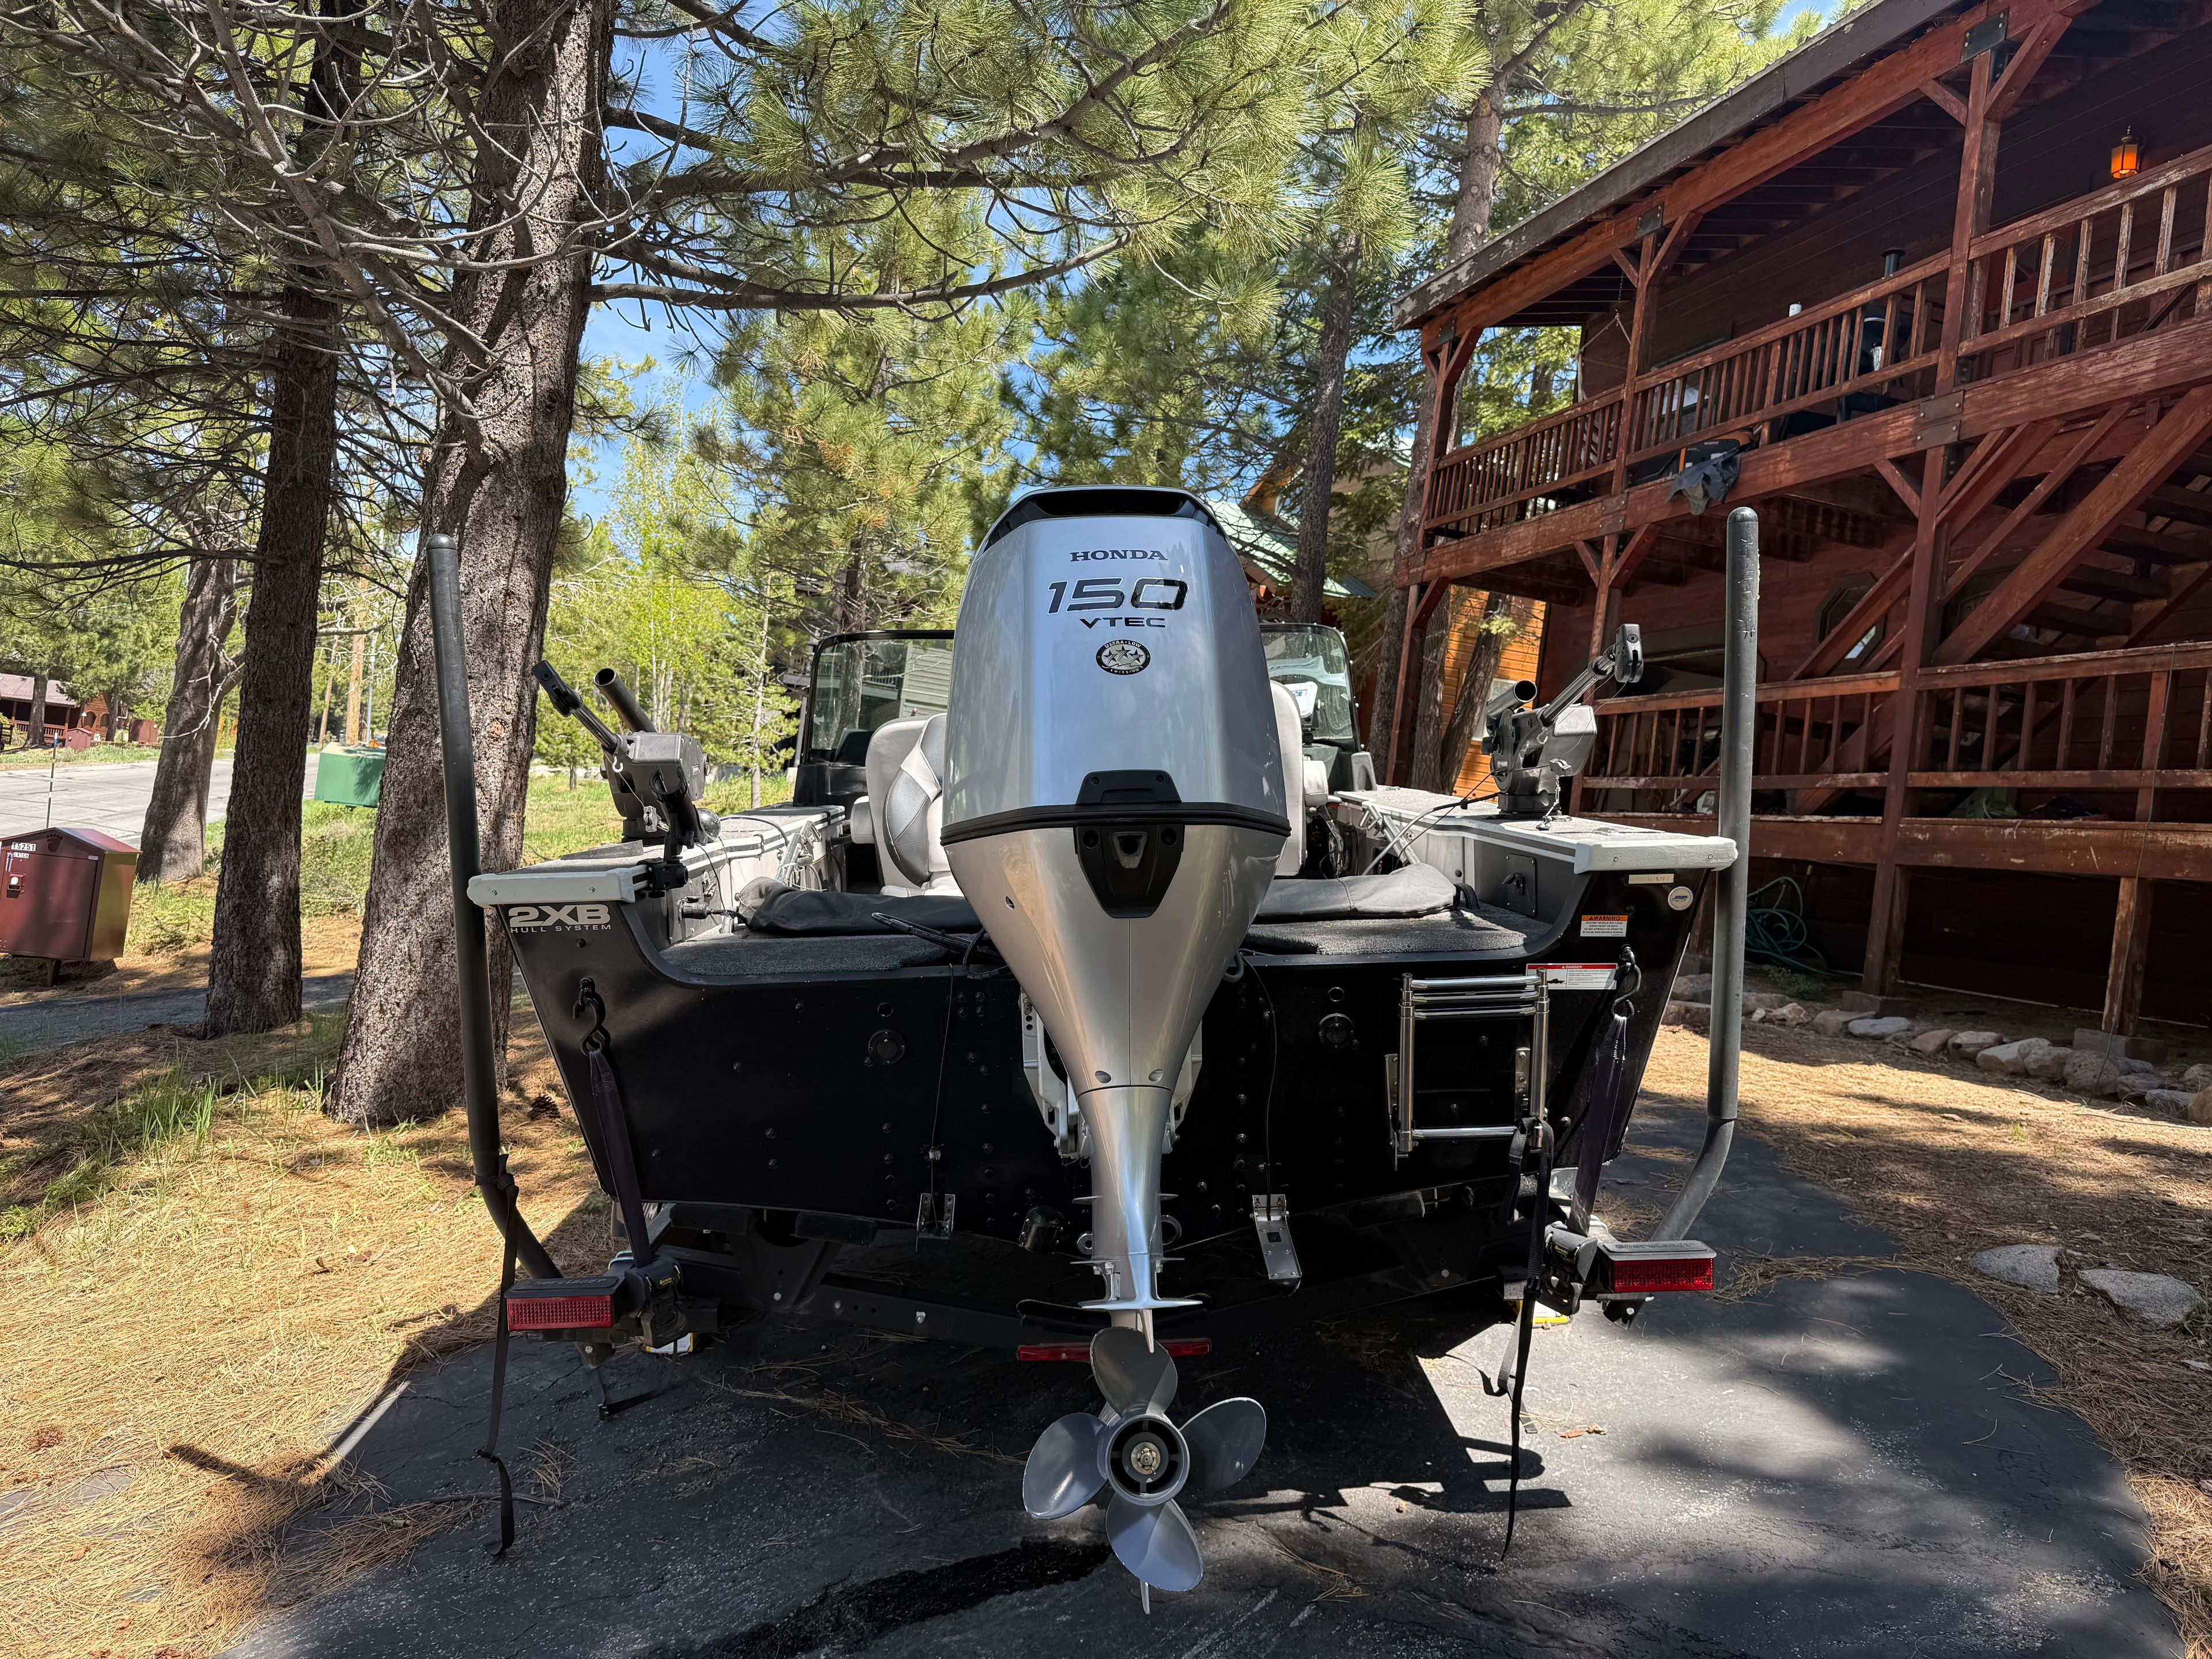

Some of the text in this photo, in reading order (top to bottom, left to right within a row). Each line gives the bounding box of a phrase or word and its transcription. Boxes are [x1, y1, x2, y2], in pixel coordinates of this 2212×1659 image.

[1070, 550, 1168, 562] HONDA
[1047, 577, 1189, 615] 150
[1079, 617, 1166, 629] VTEC
[508, 904, 611, 927] 2XB
